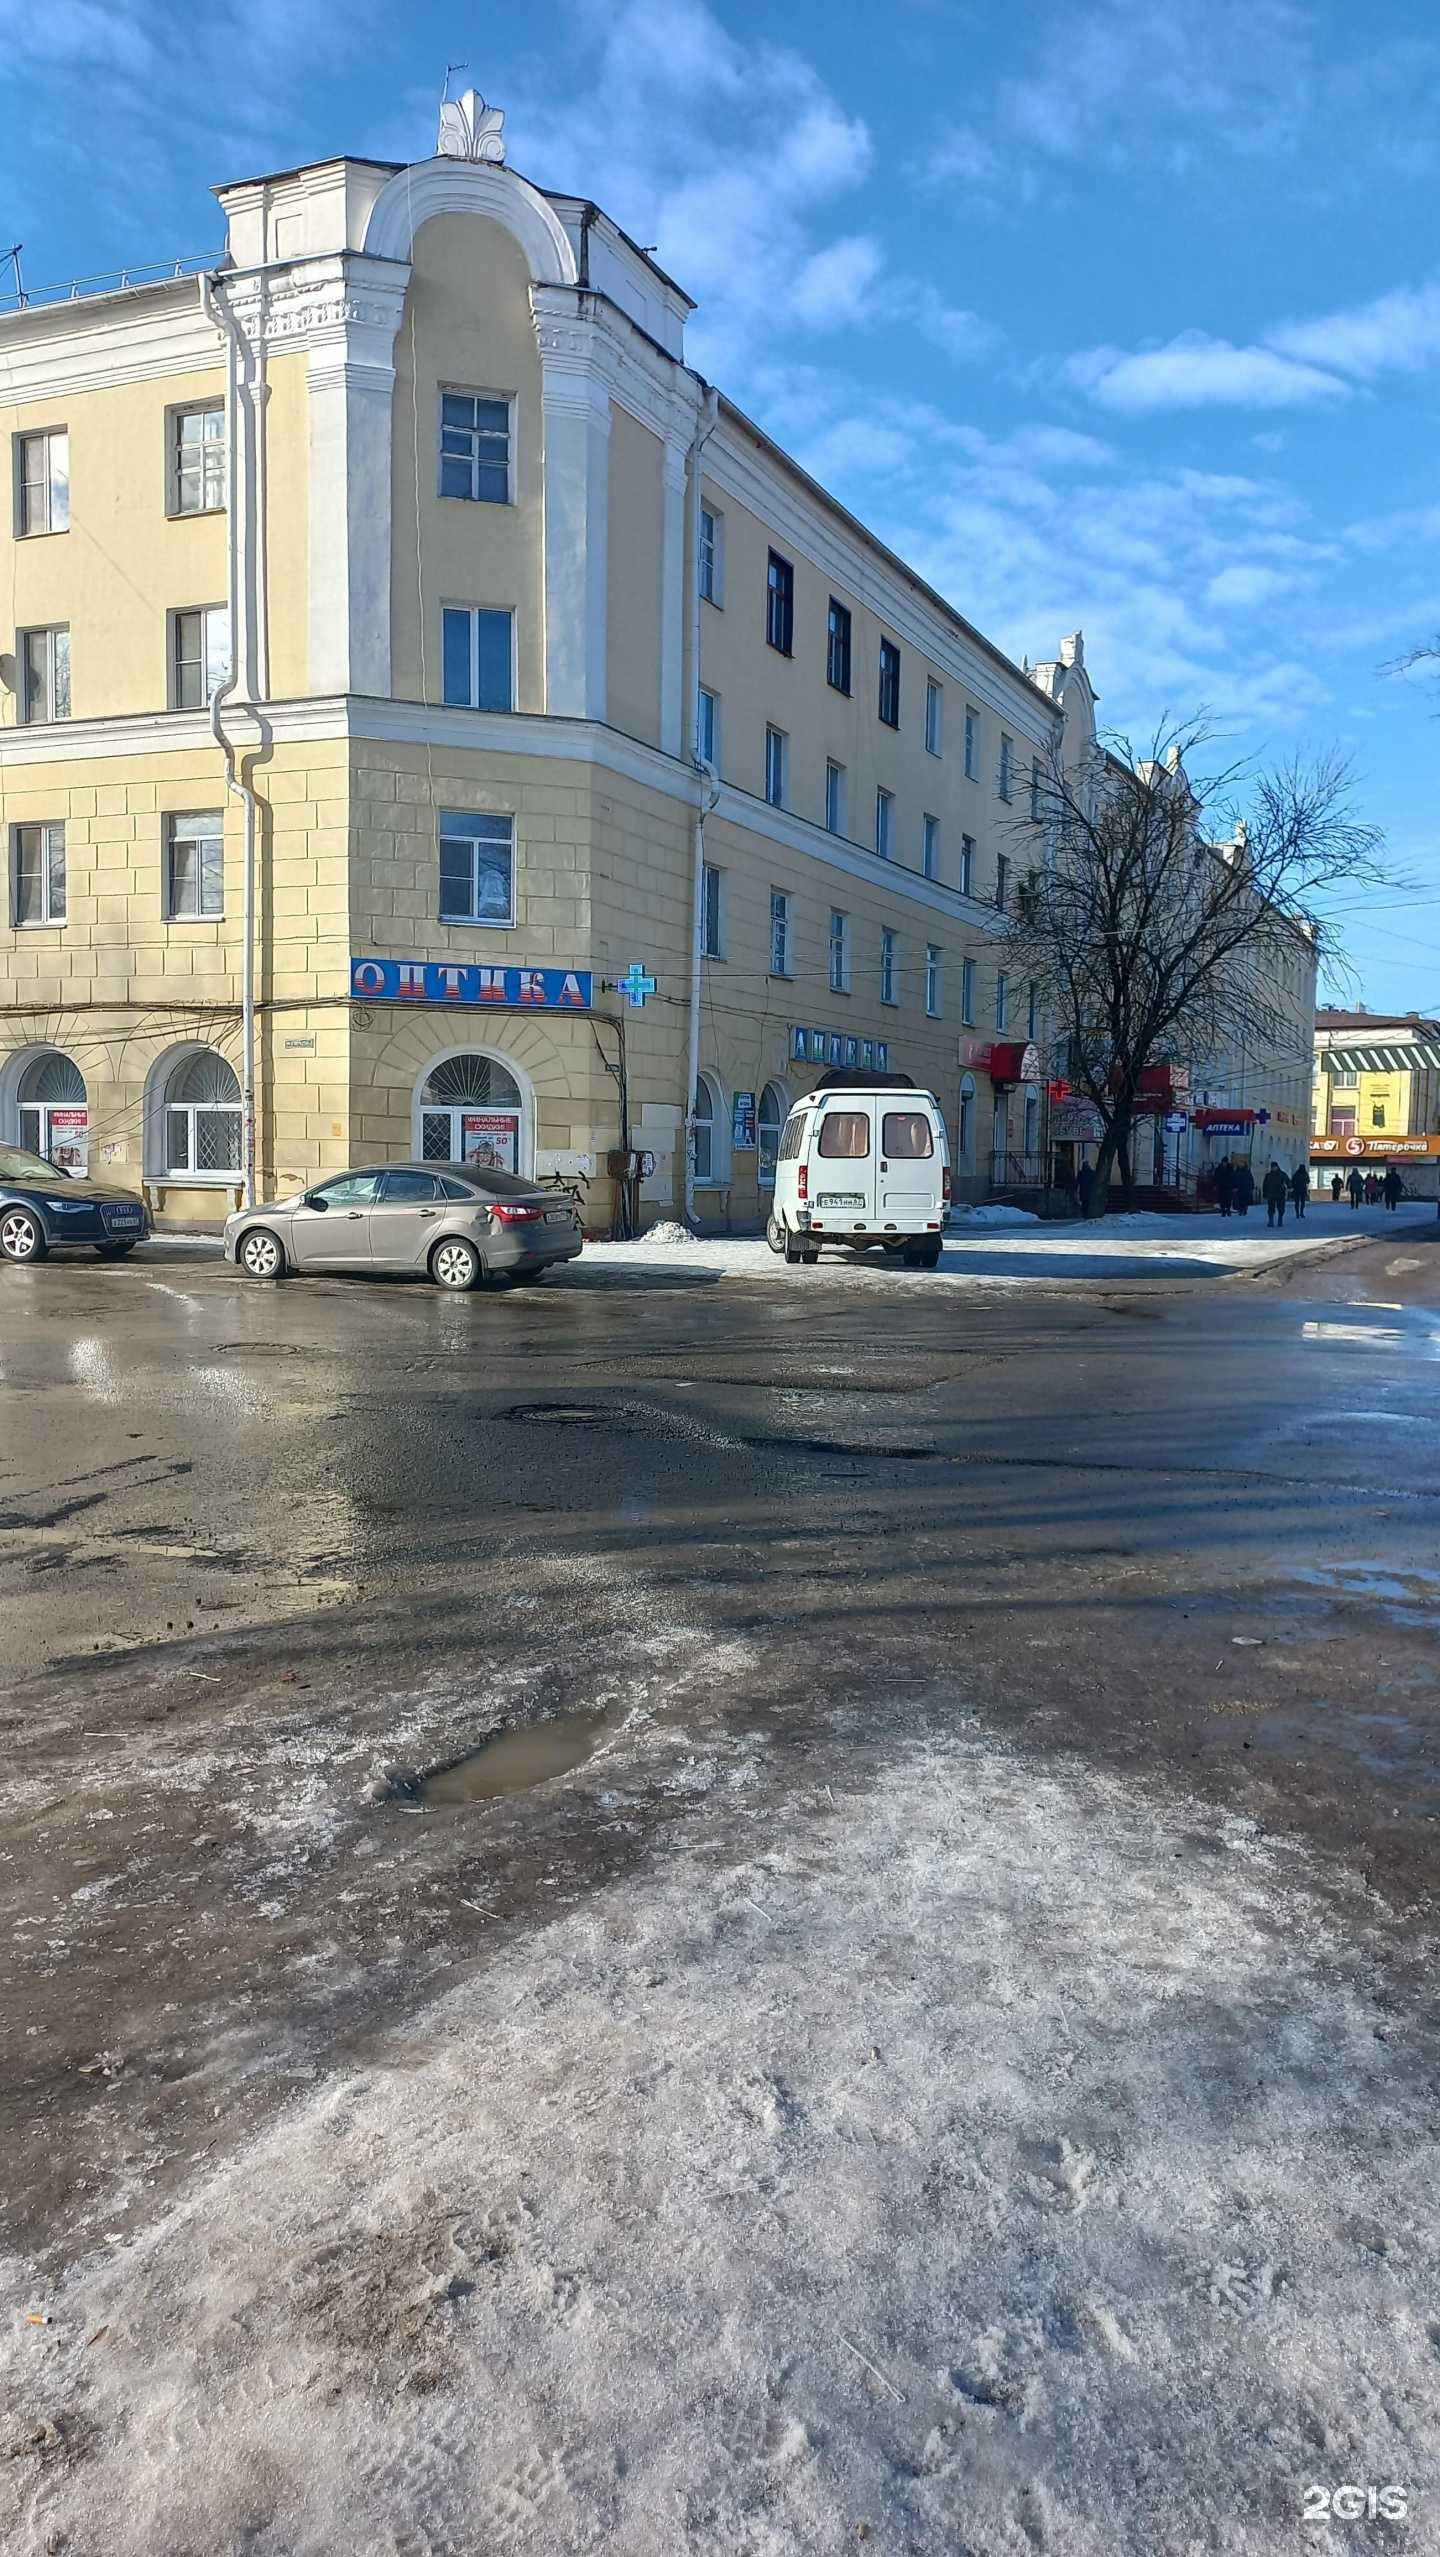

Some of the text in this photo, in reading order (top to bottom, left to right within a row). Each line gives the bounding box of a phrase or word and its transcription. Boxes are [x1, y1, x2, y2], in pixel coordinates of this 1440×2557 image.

[353, 961, 584, 1005] ОПТИКА
[796, 1031, 885, 1066] АПТЕКА
[1206, 1123, 1241, 1132] АПТЕКА
